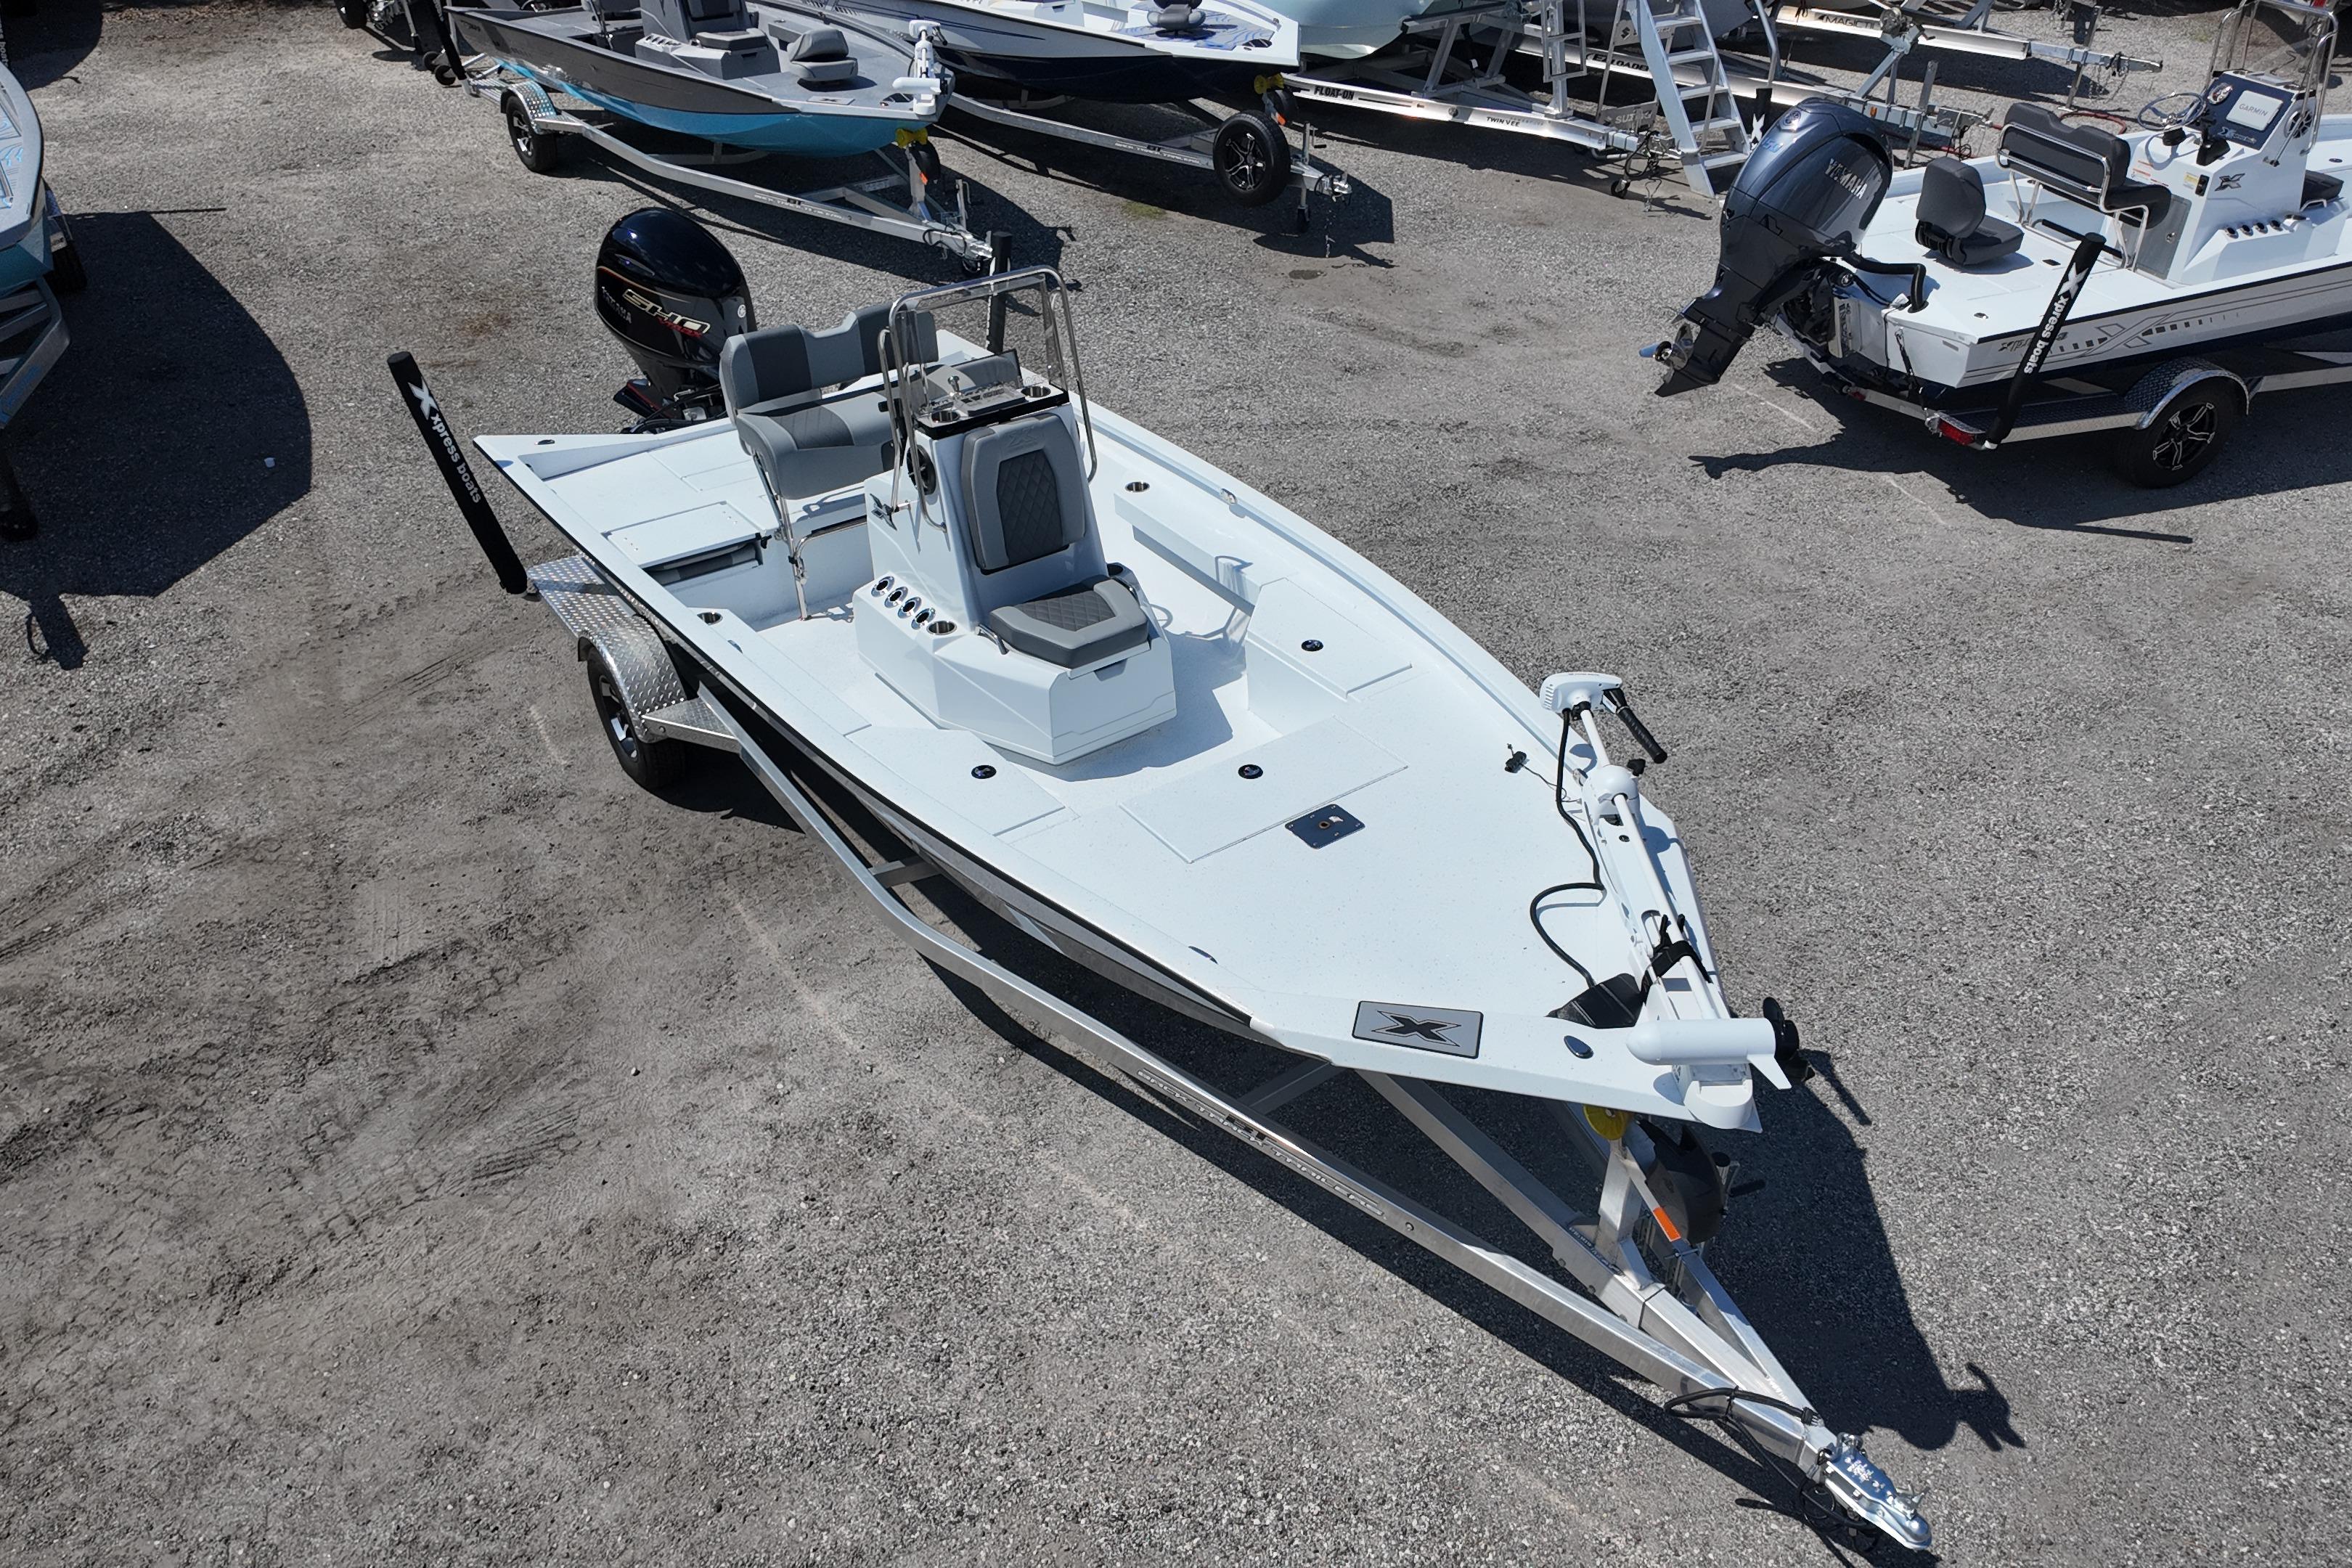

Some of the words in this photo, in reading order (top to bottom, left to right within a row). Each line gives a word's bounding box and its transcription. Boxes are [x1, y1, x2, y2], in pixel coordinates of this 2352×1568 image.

[1314, 85, 1355, 101] FLOAT-ON
[2239, 103, 2269, 117] GARMIN
[1825, 158, 1868, 200] YAMAHA
[2041, 295, 2070, 339] xpress
[2023, 339, 2050, 375] boats
[430, 412, 460, 463] xpress
[456, 461, 482, 505] boats
